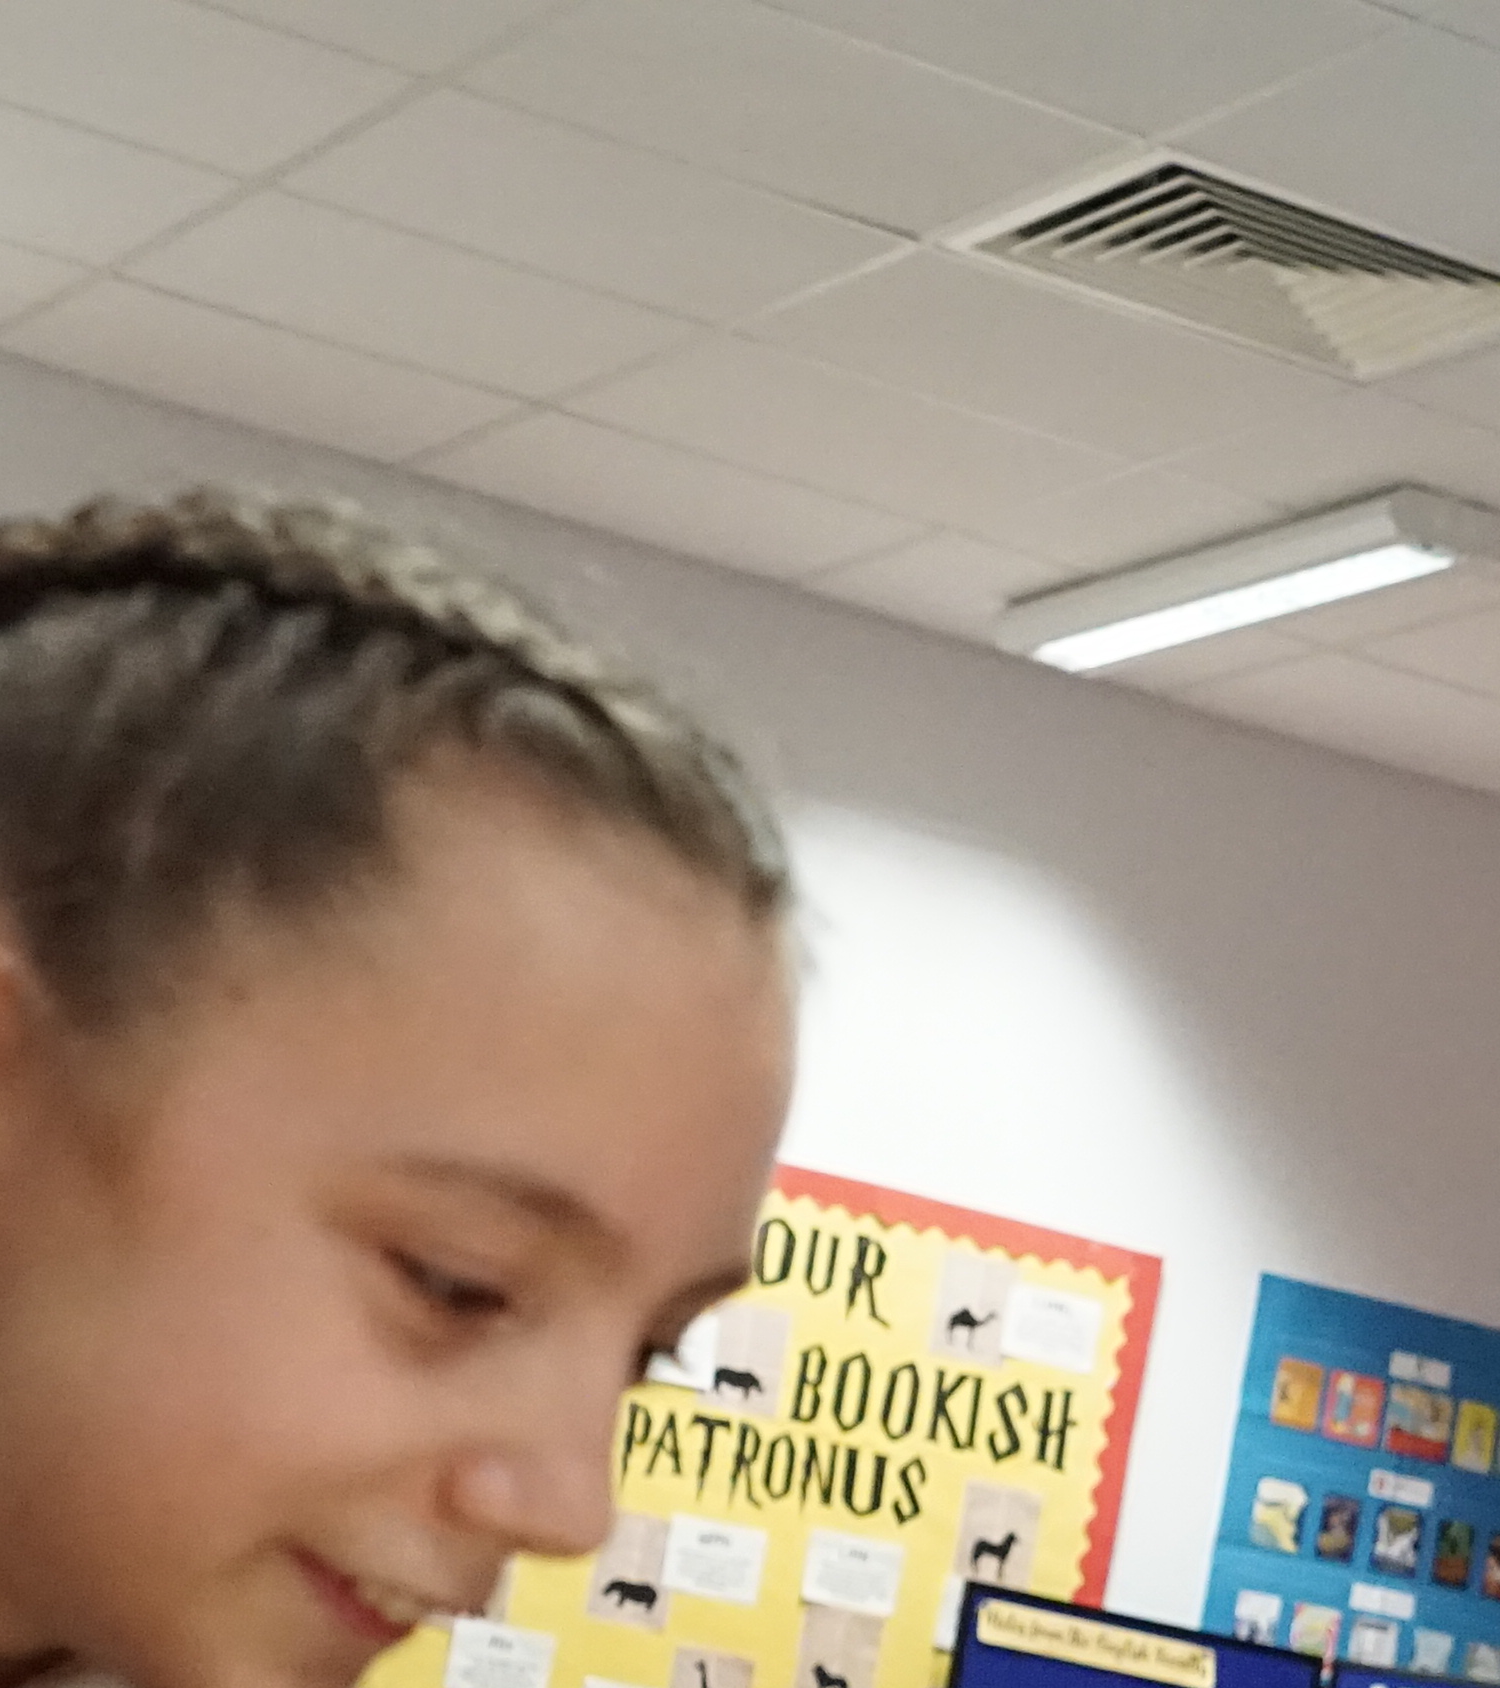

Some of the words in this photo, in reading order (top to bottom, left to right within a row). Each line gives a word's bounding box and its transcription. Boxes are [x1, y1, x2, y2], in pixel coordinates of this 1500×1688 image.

[753, 1217, 889, 1328] OUR
[620, 1401, 928, 1525] PATRONUS
[790, 1345, 1077, 1472] BOOKISH
